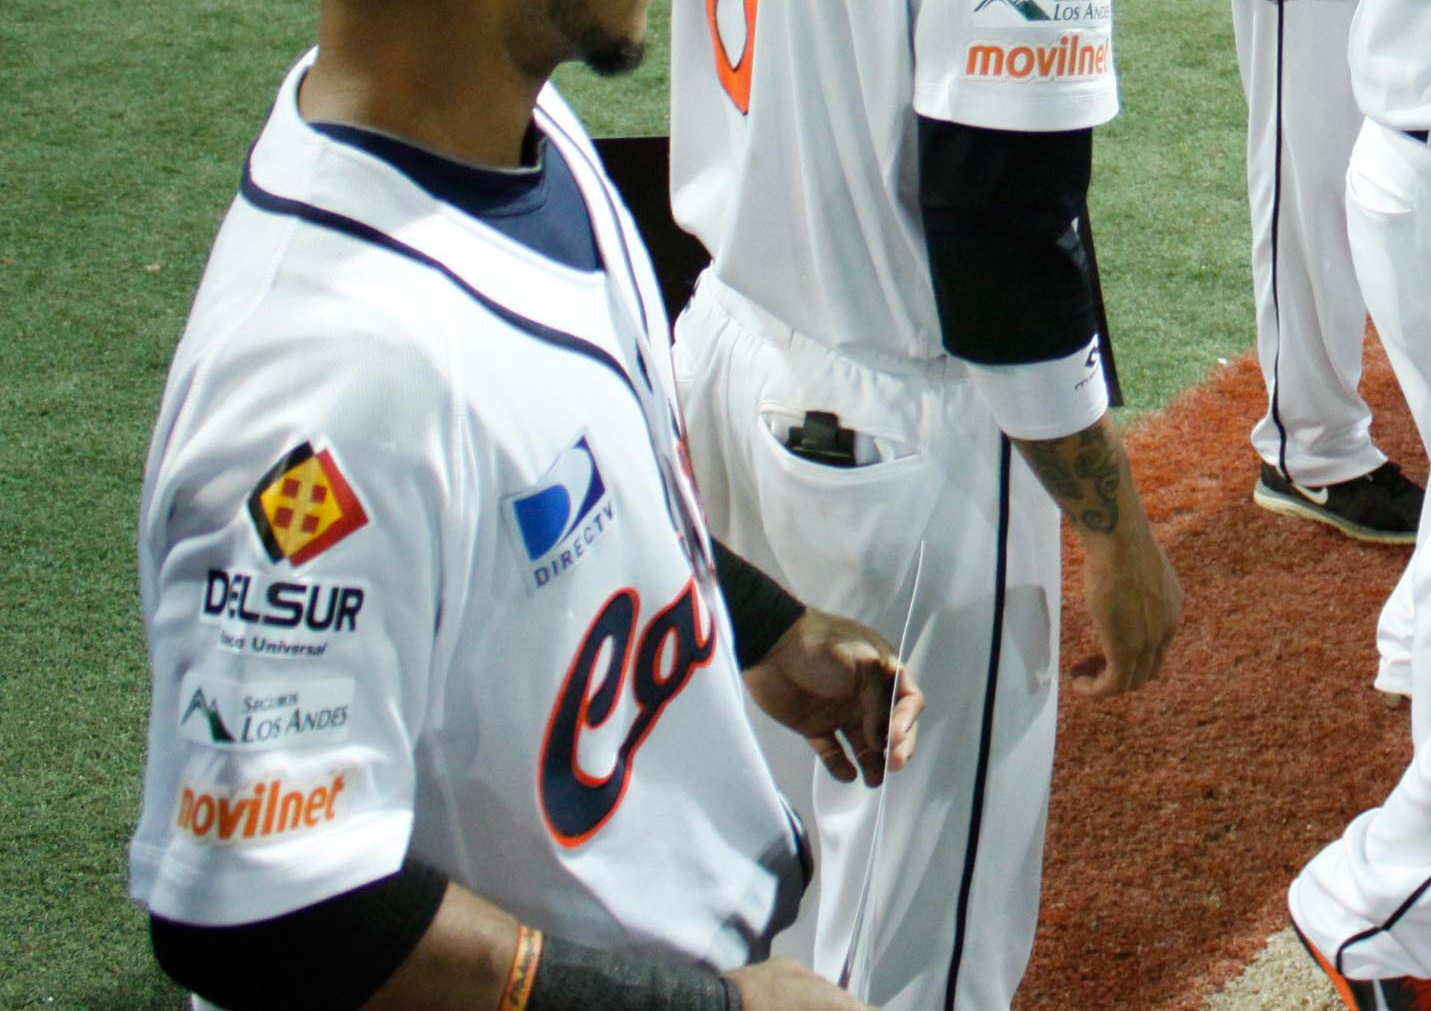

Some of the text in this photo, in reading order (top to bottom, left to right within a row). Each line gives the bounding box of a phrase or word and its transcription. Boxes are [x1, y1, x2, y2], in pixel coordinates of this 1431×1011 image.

[1083, 2, 1110, 20] ANDE
[532, 500, 614, 588] DIRECTV
[203, 568, 366, 632] DELSUR
[251, 636, 328, 657] Universal
